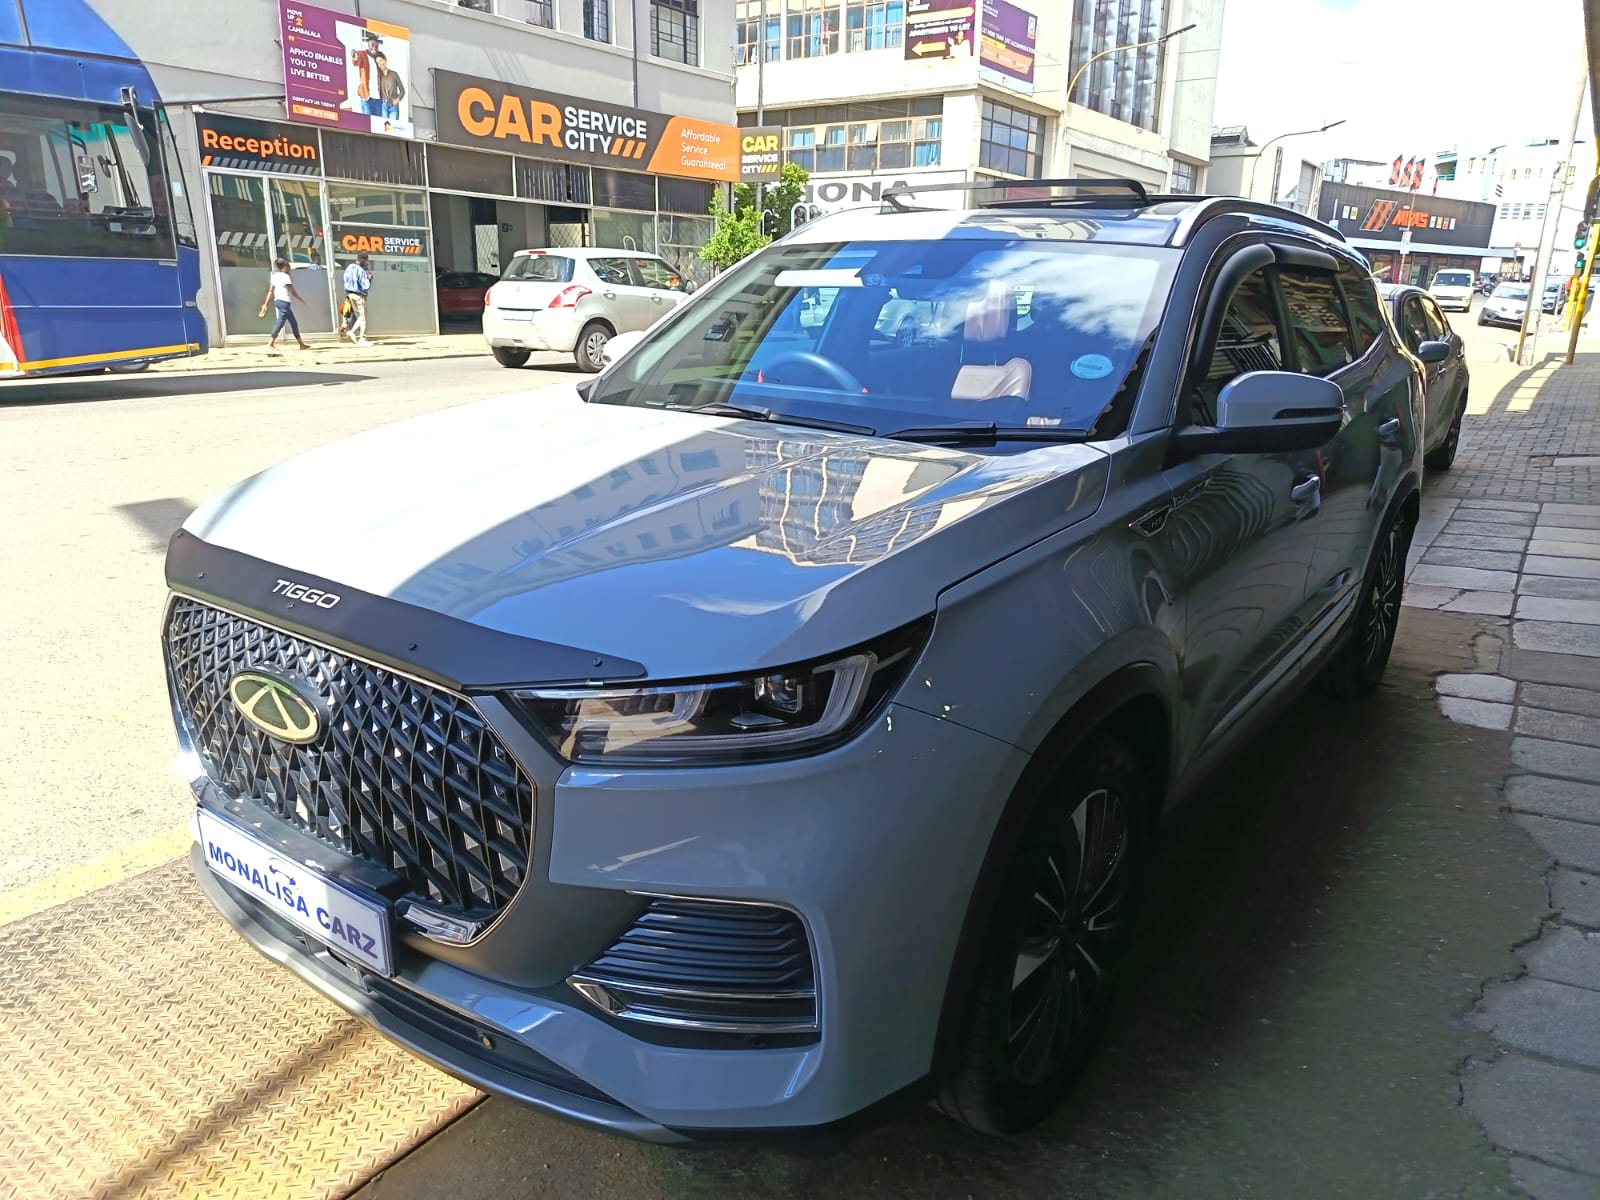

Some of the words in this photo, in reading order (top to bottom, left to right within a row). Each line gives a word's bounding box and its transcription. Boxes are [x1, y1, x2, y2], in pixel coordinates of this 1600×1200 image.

[286, 8, 303, 17] MOVE
[290, 47, 314, 58] AFHCO
[314, 52, 344, 66] ENABLES
[290, 57, 306, 67] YOU
[307, 61, 318, 70] TO
[290, 67, 305, 77] LIVE
[306, 70, 331, 82] BETTER
[457, 87, 564, 148] CAR
[564, 106, 647, 139] SERVICE
[564, 130, 613, 154] CITY
[681, 128, 720, 144] Affordable
[741, 135, 778, 153] CAR
[202, 129, 317, 160] Reception
[681, 141, 708, 155] Service
[681, 155, 727, 170] Guaranteed!
[741, 153, 778, 163] SERVICE
[741, 164, 762, 174] CITY
[342, 234, 385, 252] CAR
[384, 236, 421, 246] SERVICE
[384, 244, 405, 254] CITY
[272, 579, 341, 609] TIGGO
[208, 841, 310, 918] MONALISA
[316, 907, 379, 960] CARZ
